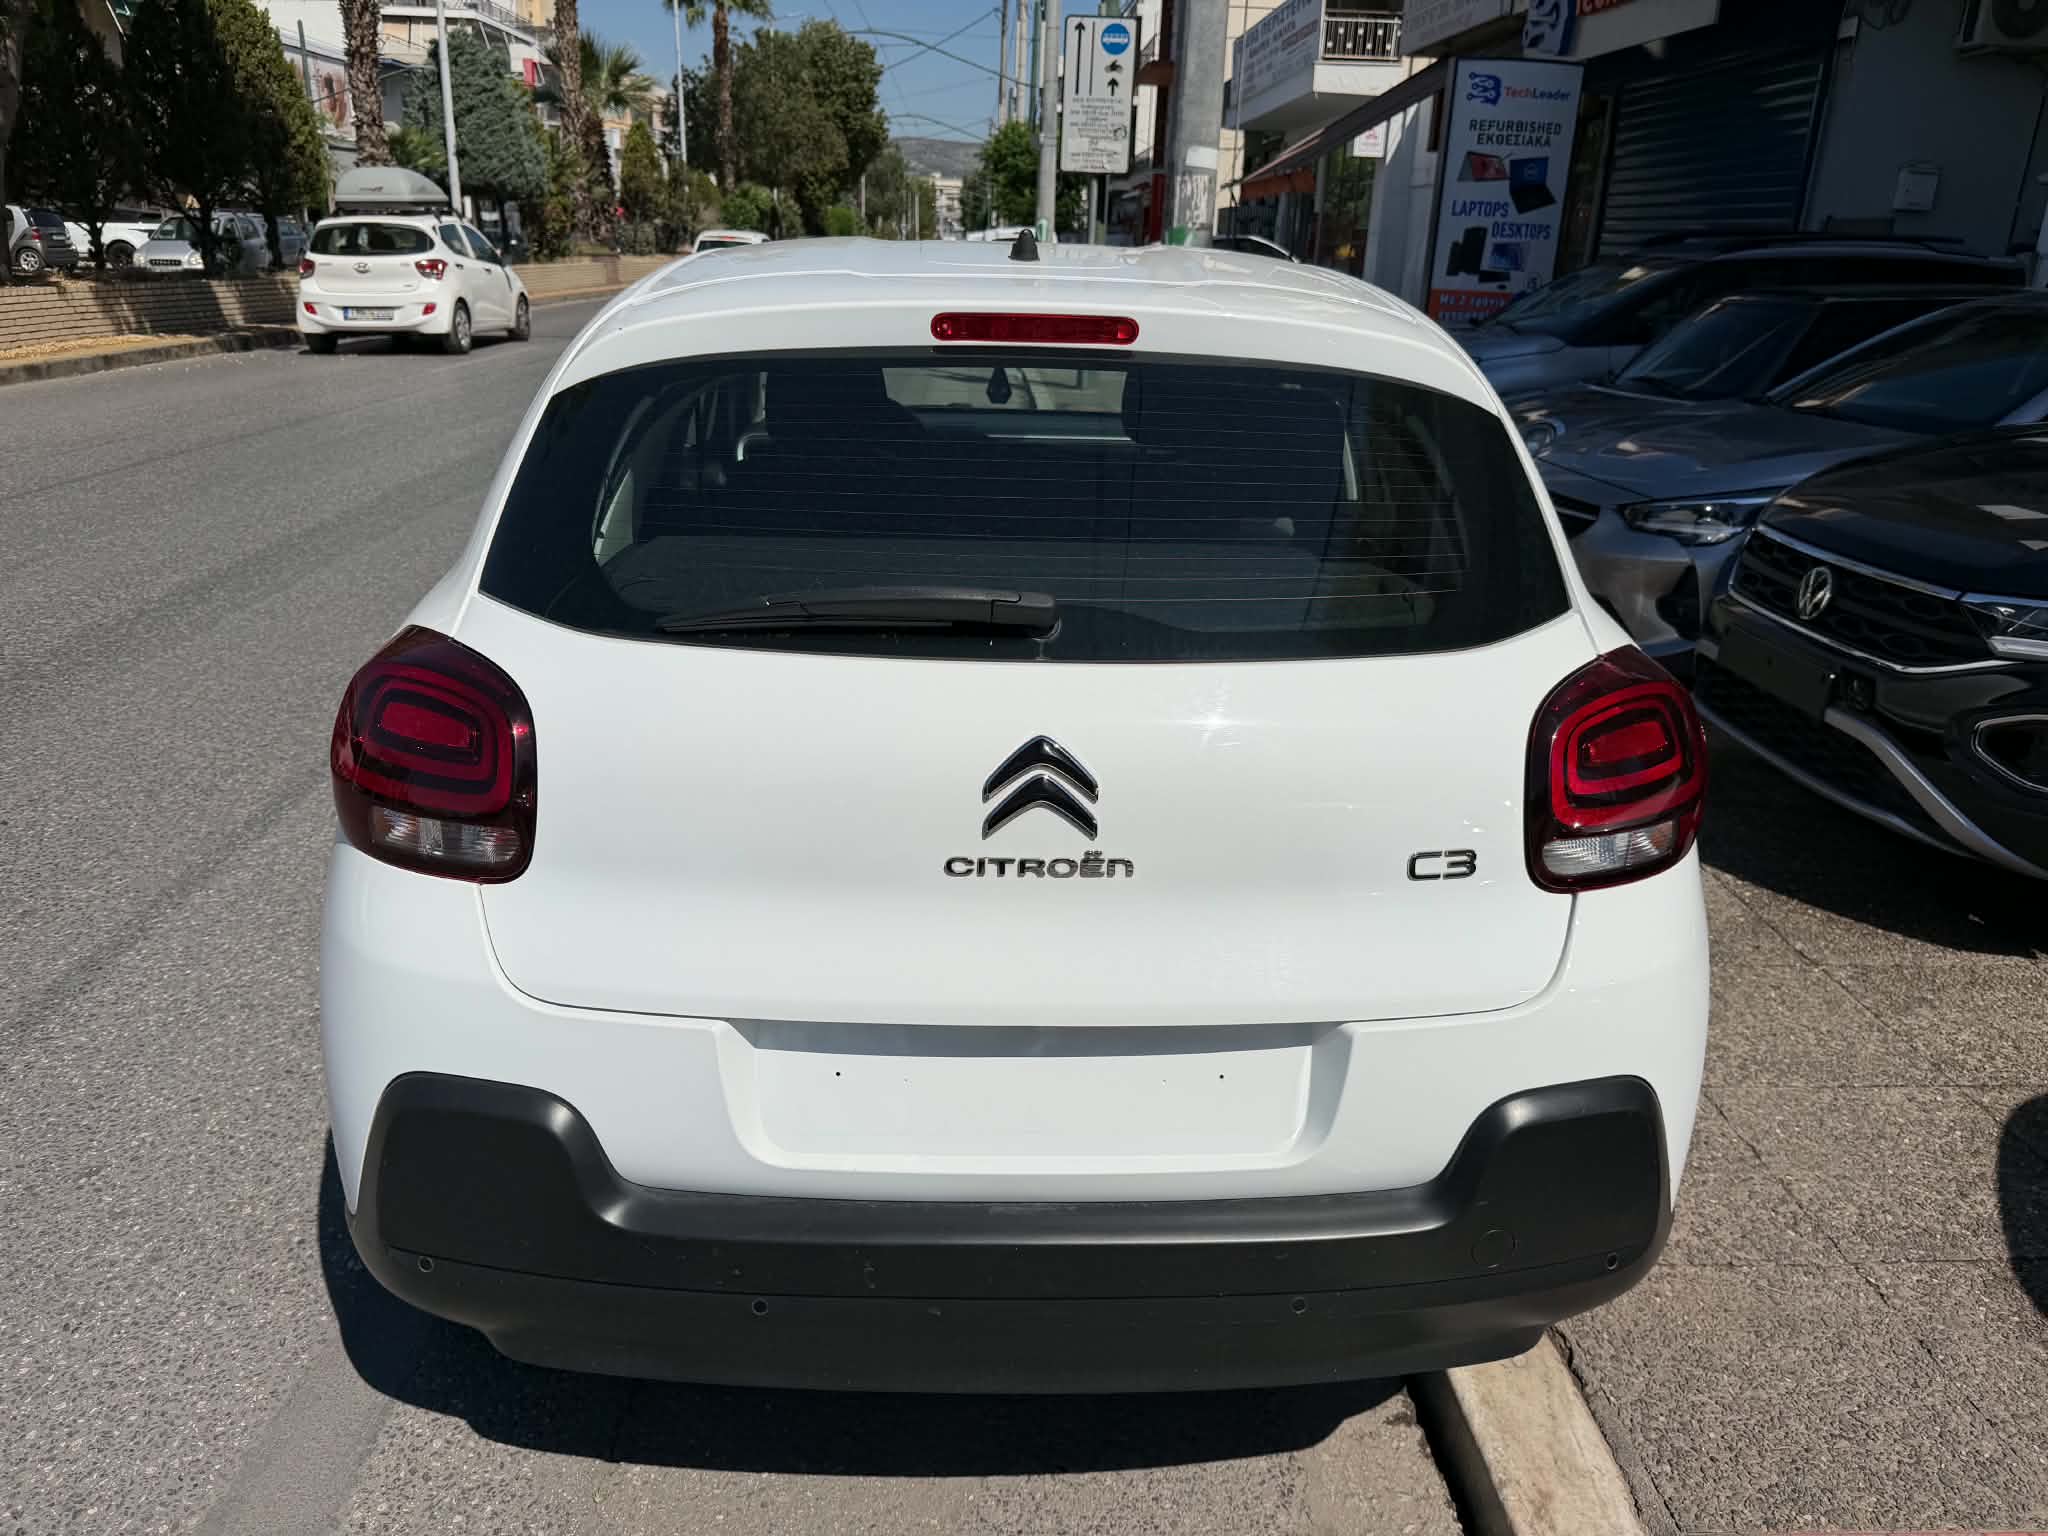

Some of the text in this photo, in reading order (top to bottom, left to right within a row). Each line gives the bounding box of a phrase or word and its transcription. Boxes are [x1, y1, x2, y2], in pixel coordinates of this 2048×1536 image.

[1504, 86, 1570, 101] TechLeader
[1468, 119, 1562, 137] REFURBISHED
[1451, 200, 1510, 217] LAPTOPS
[1491, 221, 1552, 240] DESKTOPS
[1407, 850, 1477, 881] C3
